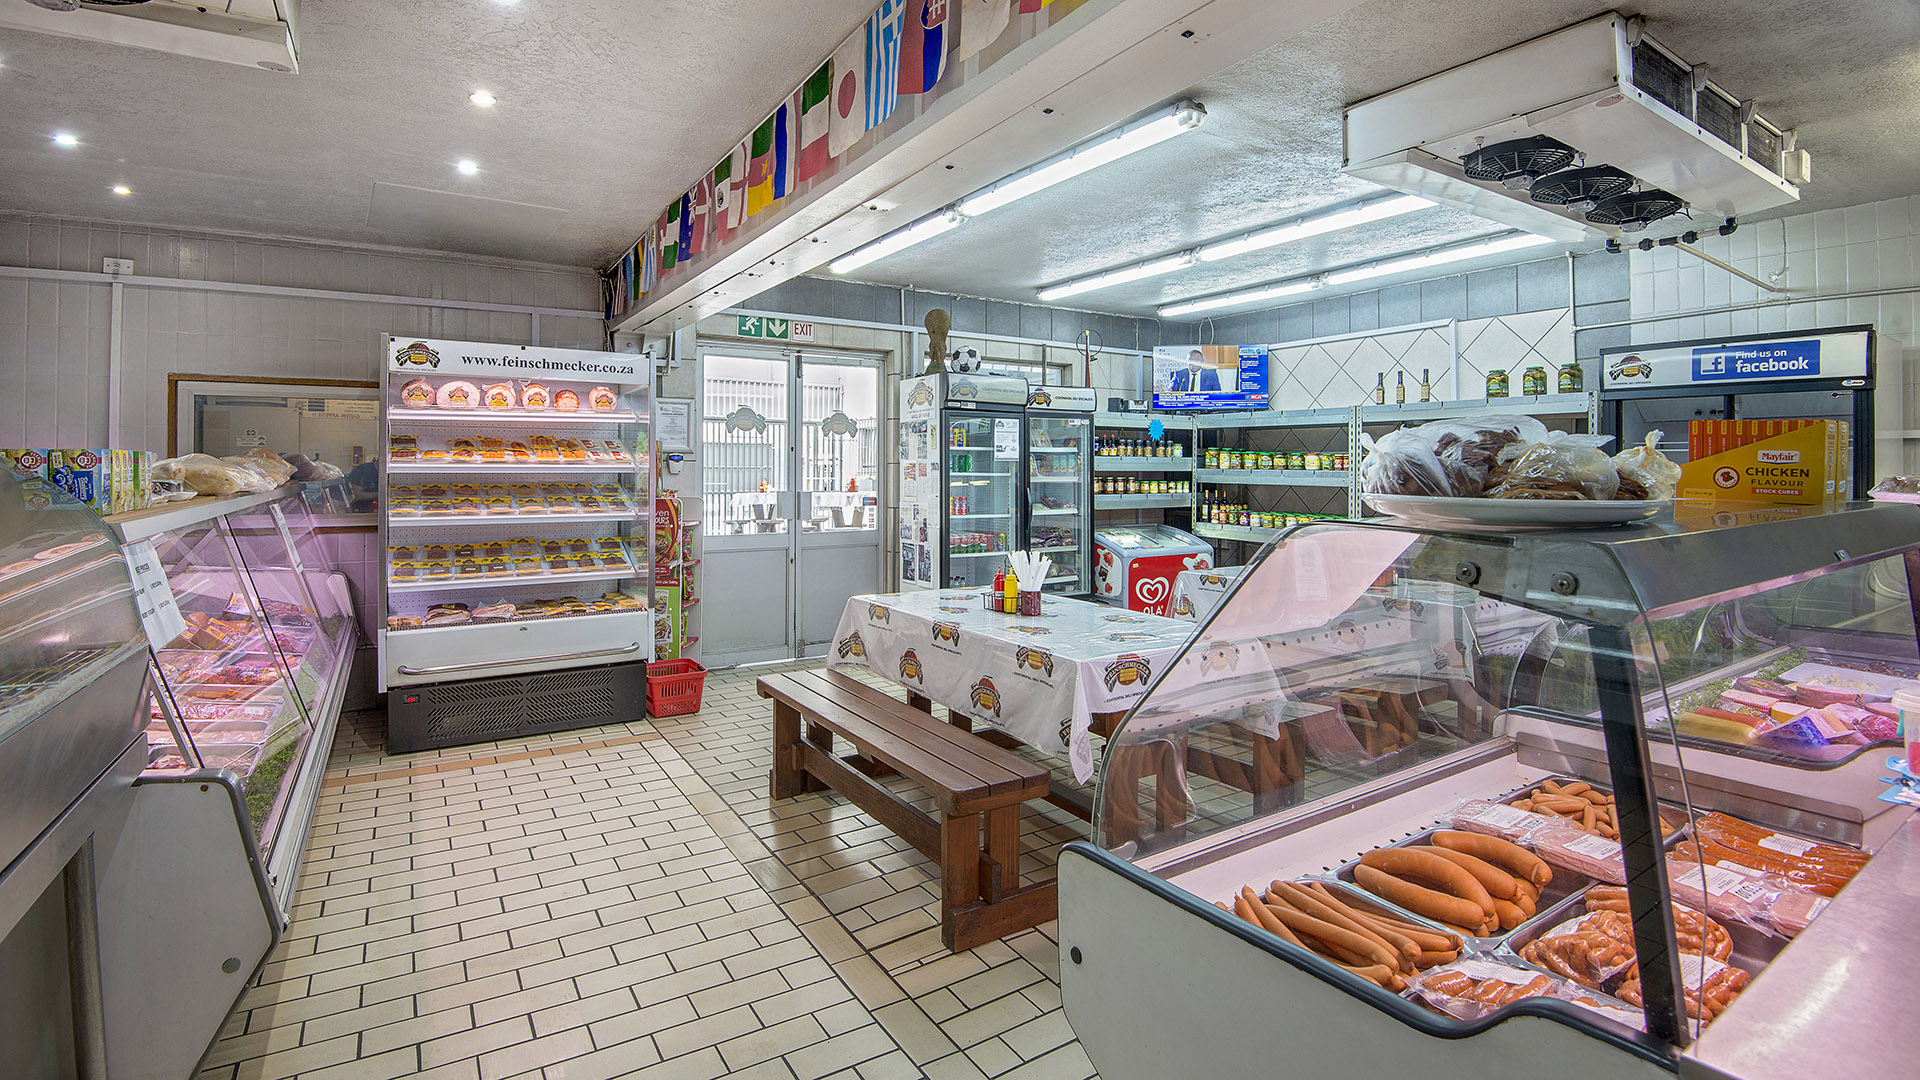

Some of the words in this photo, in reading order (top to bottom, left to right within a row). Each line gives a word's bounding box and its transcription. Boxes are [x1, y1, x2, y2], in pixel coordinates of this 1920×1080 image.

[794, 323, 813, 336] EXIT
[1736, 350, 1757, 360] Find
[1774, 349, 1787, 357] on
[461, 354, 634, 375] www.feinschmecker.co.za
[1735, 356, 1809, 373] facebook
[1761, 452, 1795, 463] Mayfair
[1745, 467, 1810, 478] CHICKEN
[1751, 479, 1804, 487] FLAVOUR
[655, 516, 670, 524] OURS
[1106, 661, 1150, 681] FEINSCHMECKER
